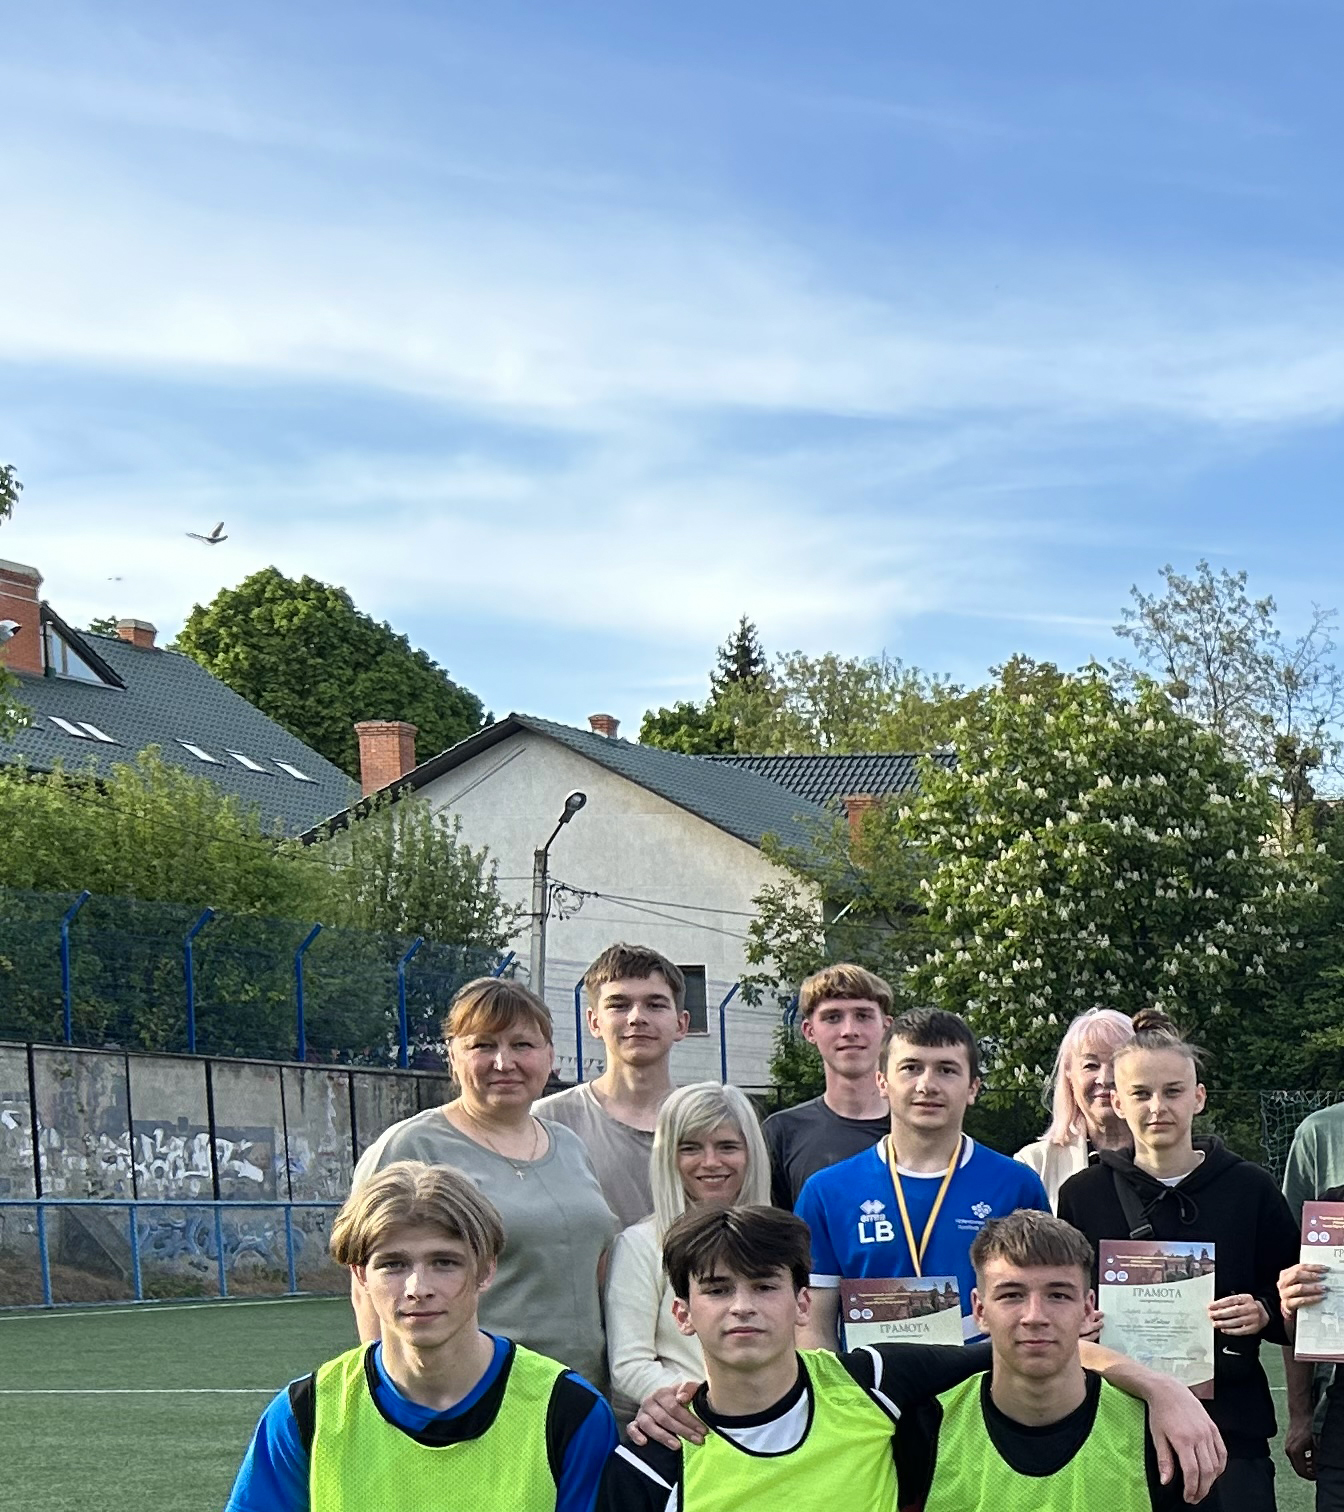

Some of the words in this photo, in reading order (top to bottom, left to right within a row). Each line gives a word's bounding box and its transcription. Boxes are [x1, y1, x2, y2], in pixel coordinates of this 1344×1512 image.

[858, 1220, 895, 1243] LB
[1133, 1288, 1182, 1298] ГРАМОТА
[880, 1323, 930, 1333] ГРАМОТА
